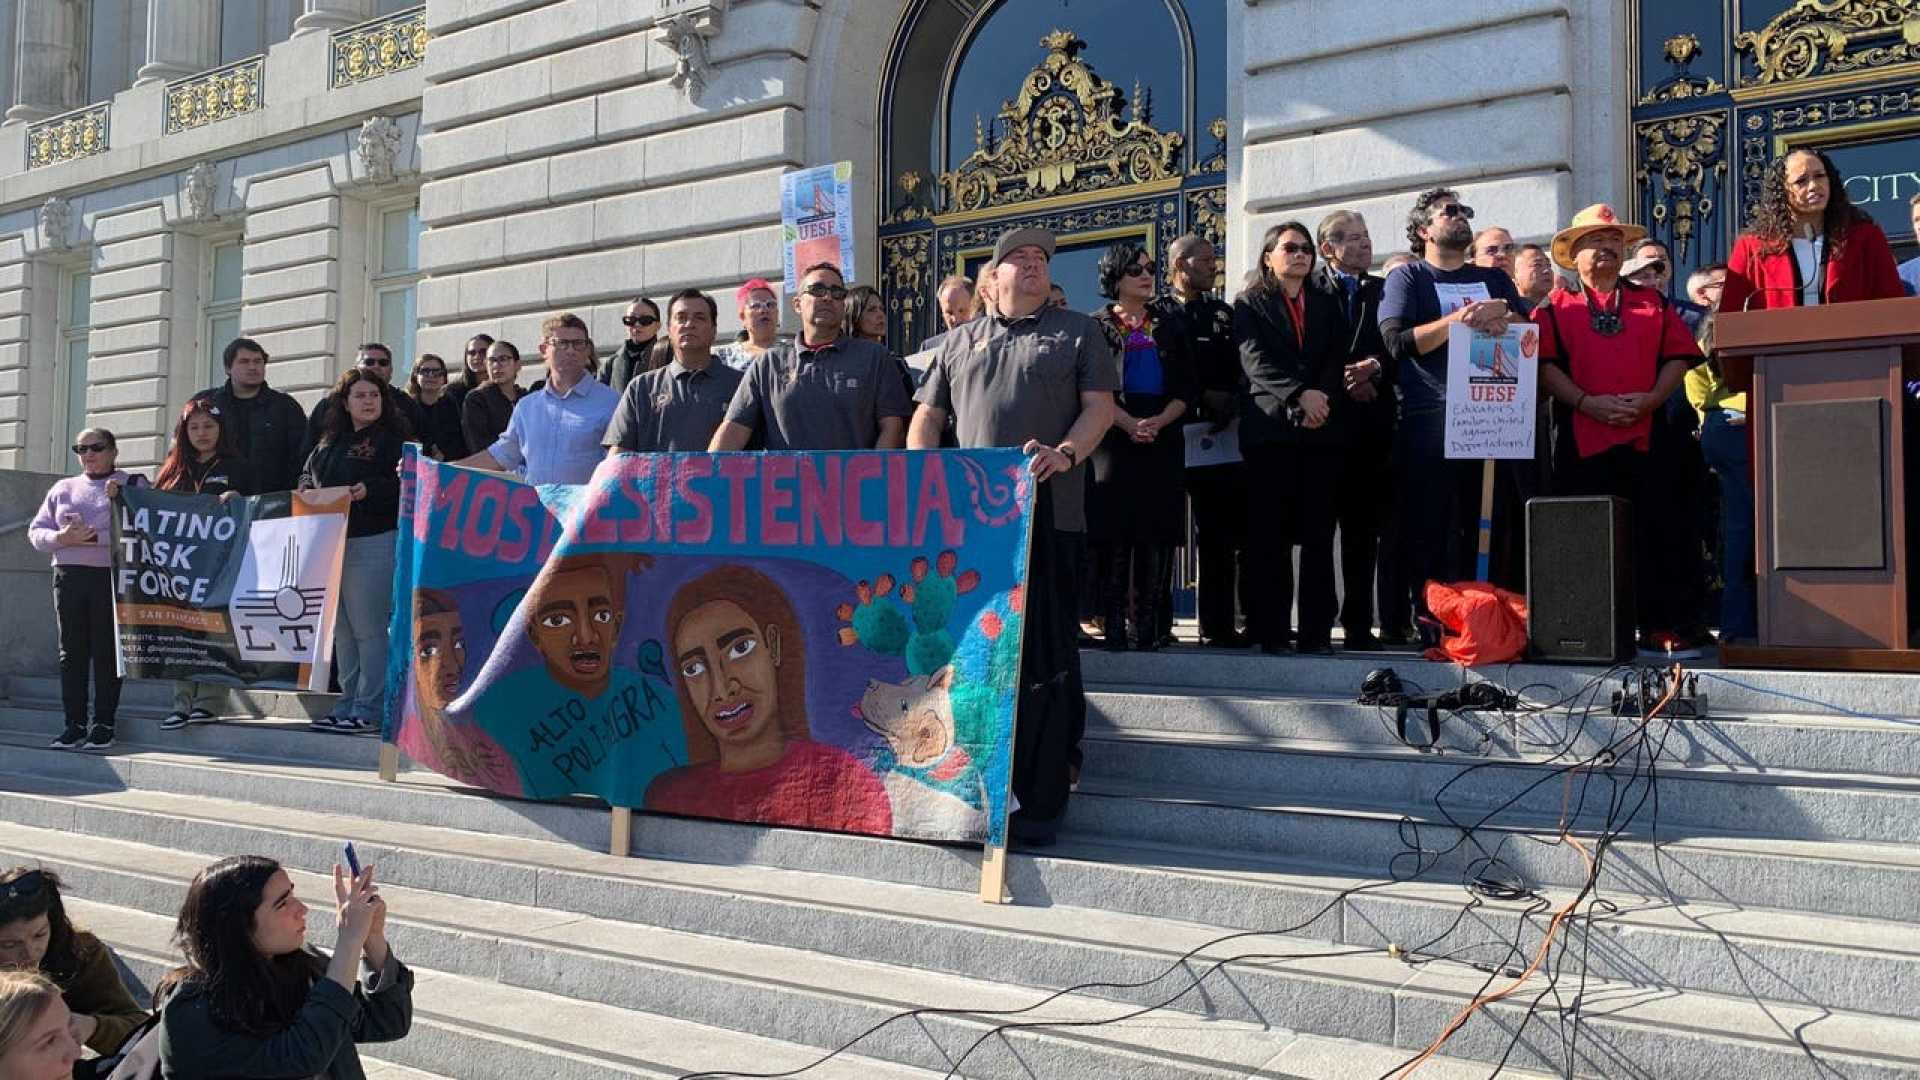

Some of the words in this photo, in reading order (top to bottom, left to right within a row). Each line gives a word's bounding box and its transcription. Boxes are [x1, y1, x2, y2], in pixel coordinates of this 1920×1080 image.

[799, 221, 835, 241] UESF
[1470, 385, 1517, 403] UESF
[122, 505, 236, 541] LATINO
[119, 536, 199, 570] TASK
[118, 569, 210, 604] FORCE
[530, 698, 587, 752] ALTO
